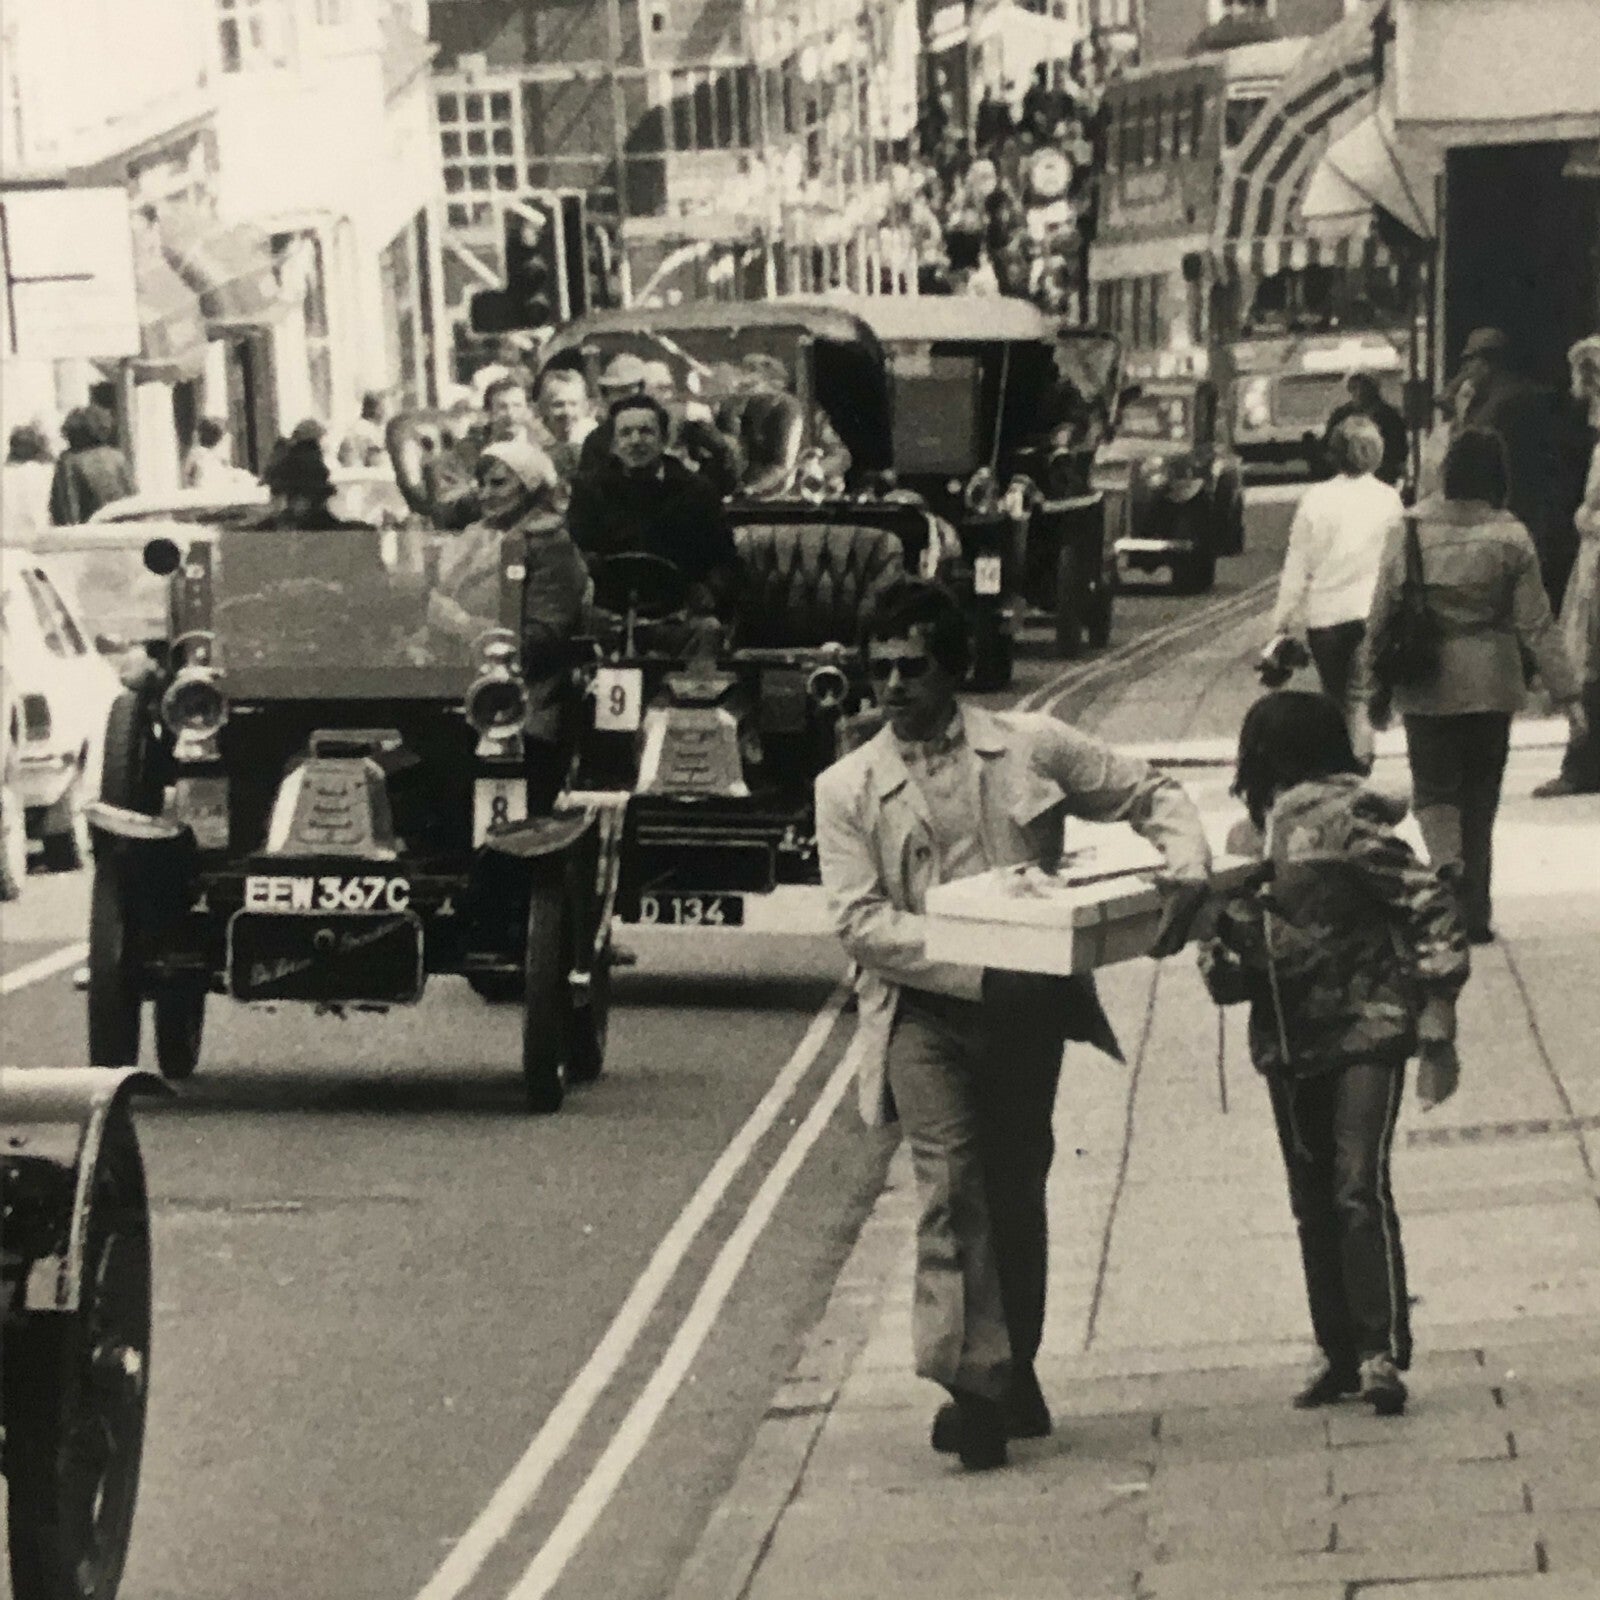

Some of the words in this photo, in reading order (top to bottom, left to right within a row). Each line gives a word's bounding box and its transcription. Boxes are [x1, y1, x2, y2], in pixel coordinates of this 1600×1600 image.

[610, 684, 626, 716] 9
[490, 795, 510, 828] 8
[245, 875, 315, 912] EEW
[318, 875, 411, 912] 367C
[672, 896, 725, 925] 134
